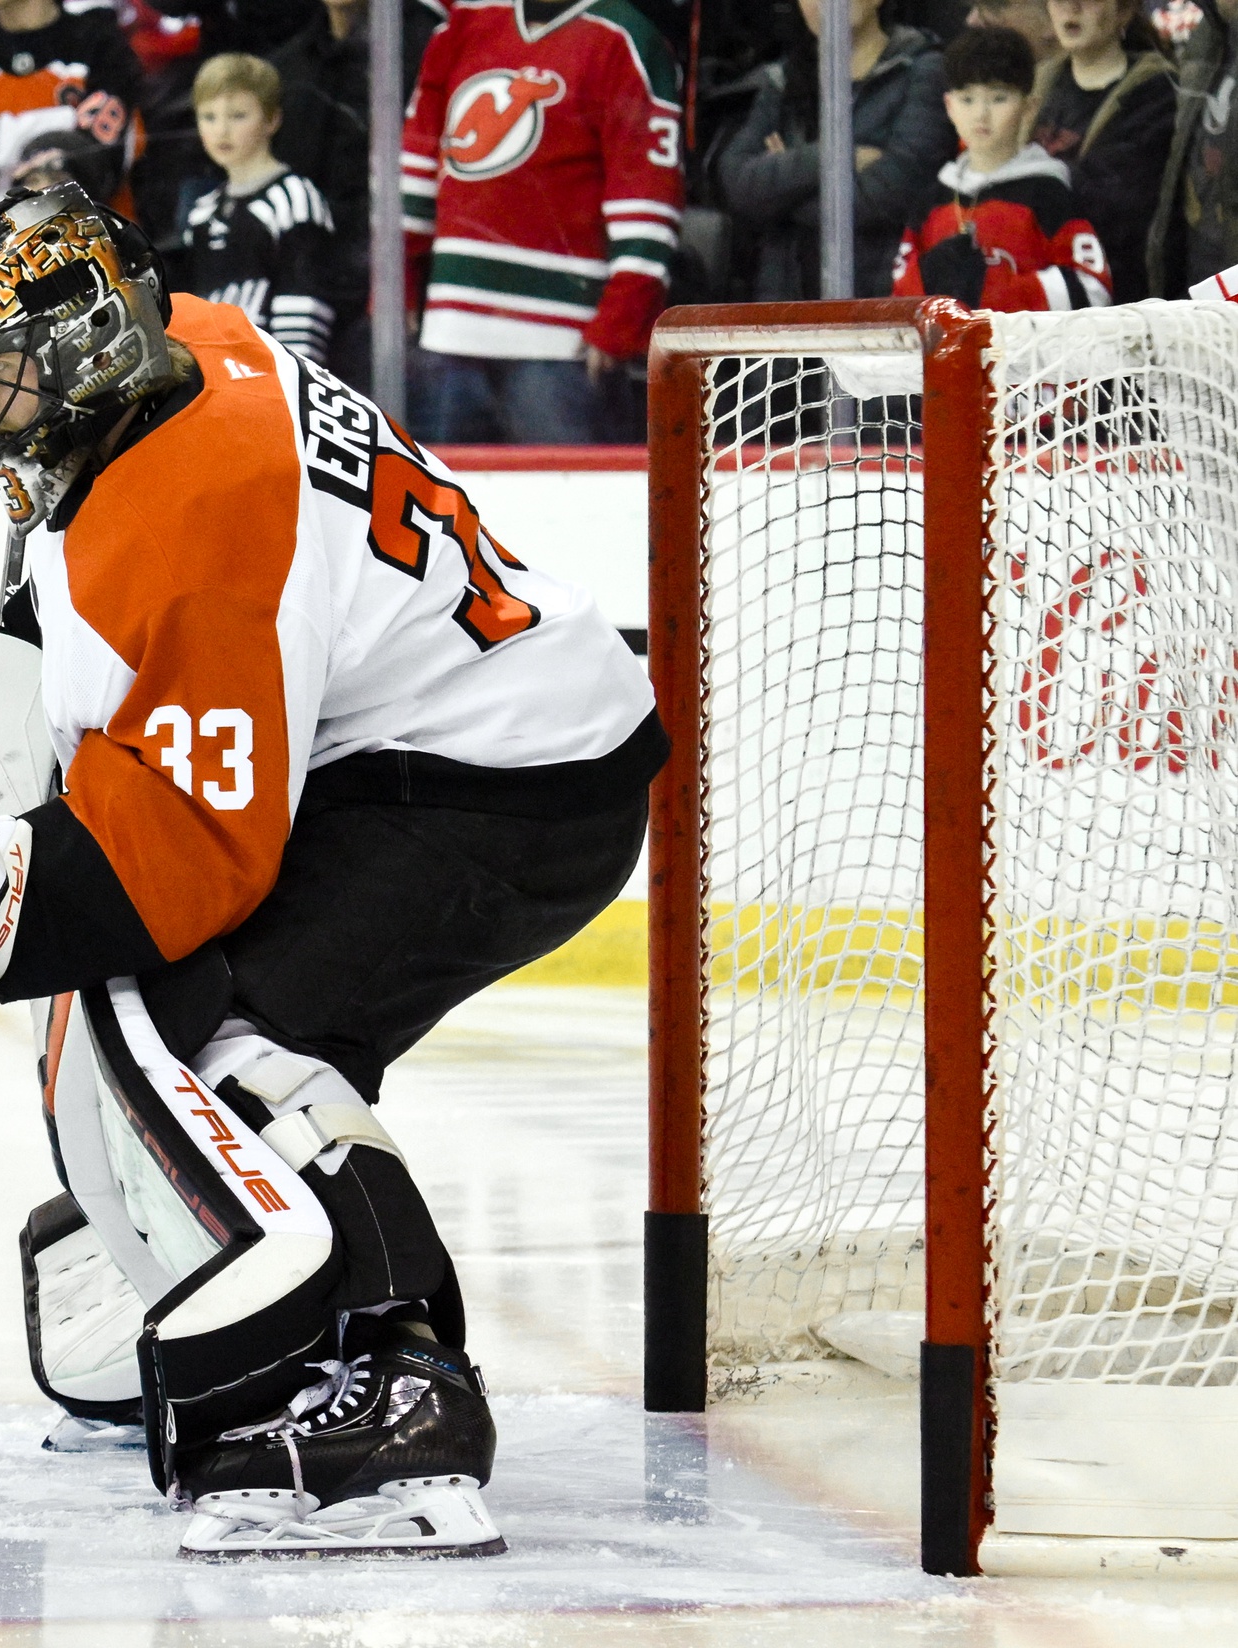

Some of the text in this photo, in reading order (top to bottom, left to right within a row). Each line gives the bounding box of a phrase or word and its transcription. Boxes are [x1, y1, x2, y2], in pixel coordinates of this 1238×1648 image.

[53, 292, 88, 322] CITY
[71, 334, 94, 353] OF
[67, 344, 140, 404] BROTHERLY
[143, 704, 255, 811] 33
[174, 1067, 291, 1214] TRUE
